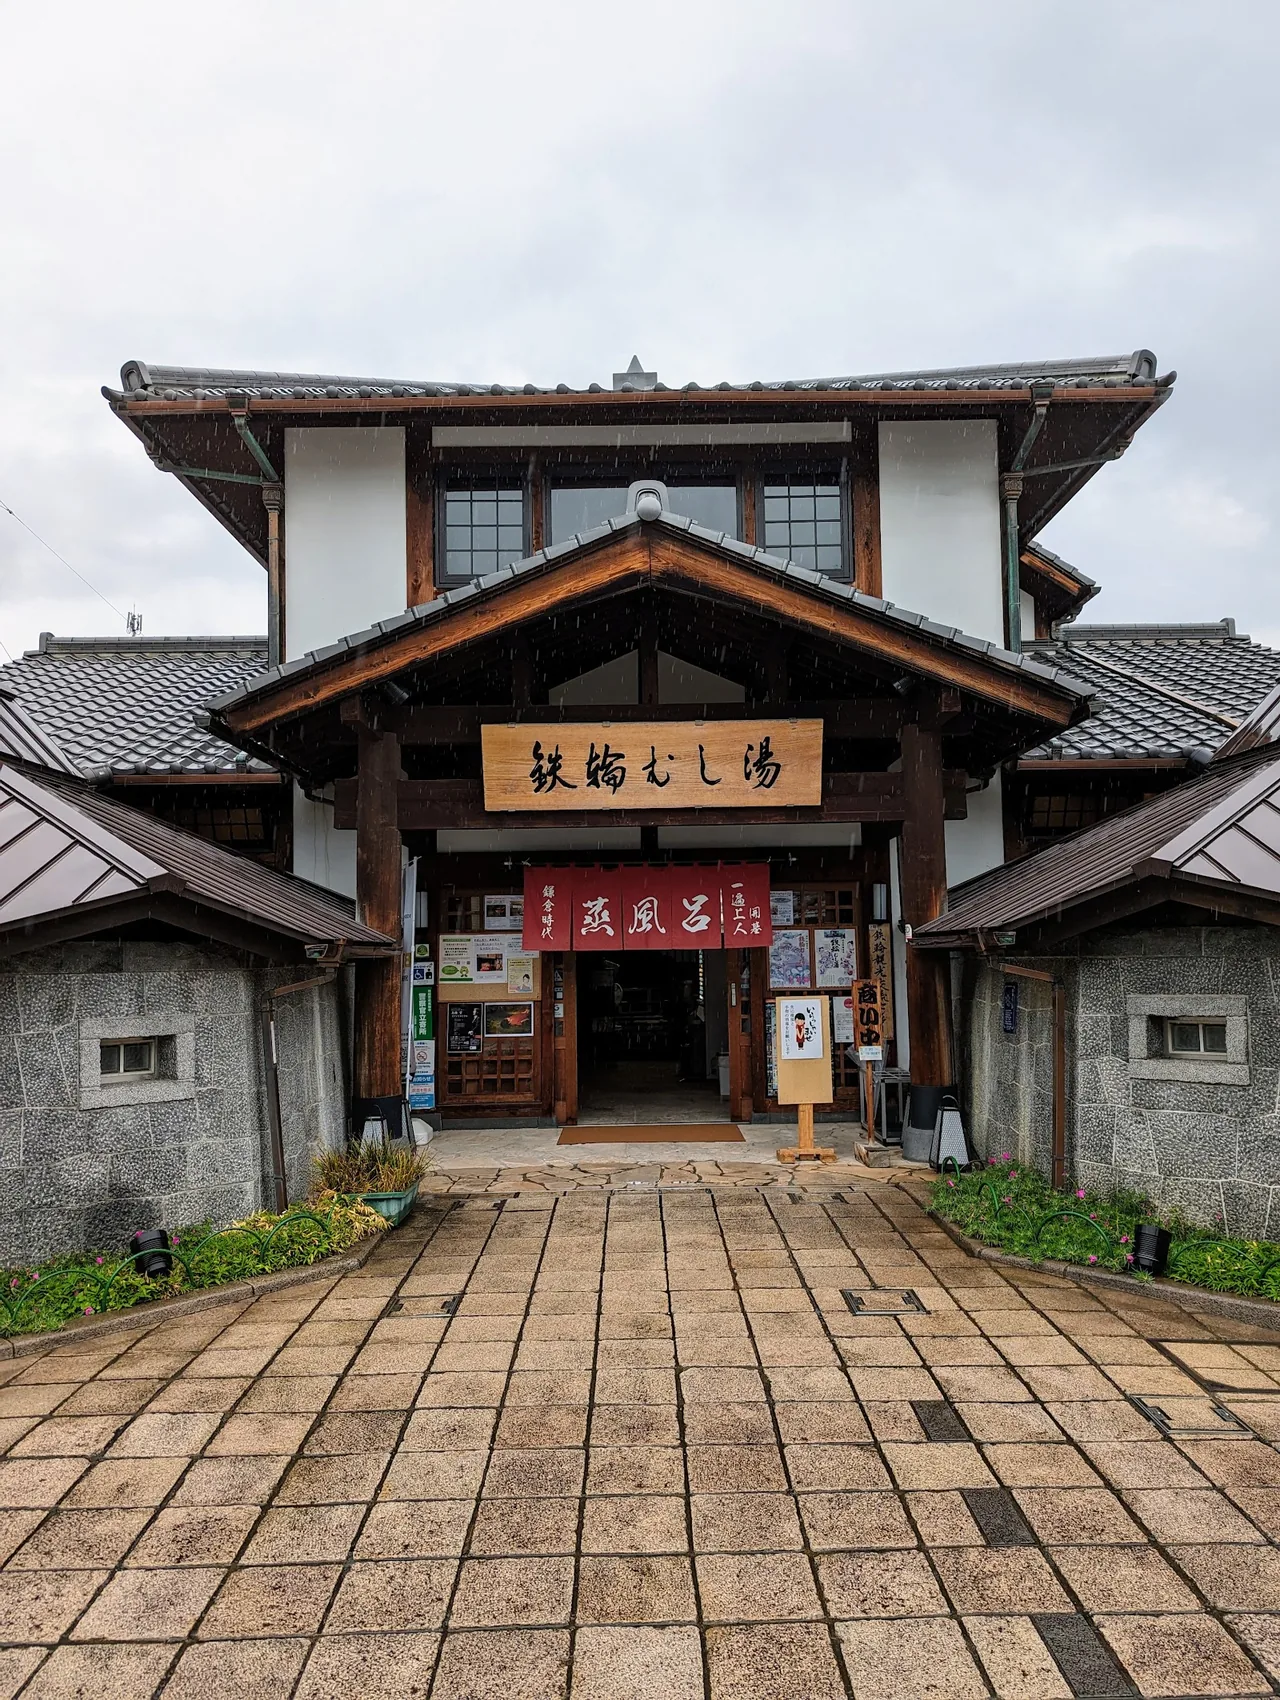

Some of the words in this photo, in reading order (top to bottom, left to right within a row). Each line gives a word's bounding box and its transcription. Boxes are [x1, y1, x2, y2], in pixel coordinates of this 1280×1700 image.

[529, 736, 782, 795] 鉄輪むし湯
[541, 885, 555, 940] 鎌倉時代
[580, 894, 712, 937] 蒸風呂
[730, 882, 748, 935] 一遍上人
